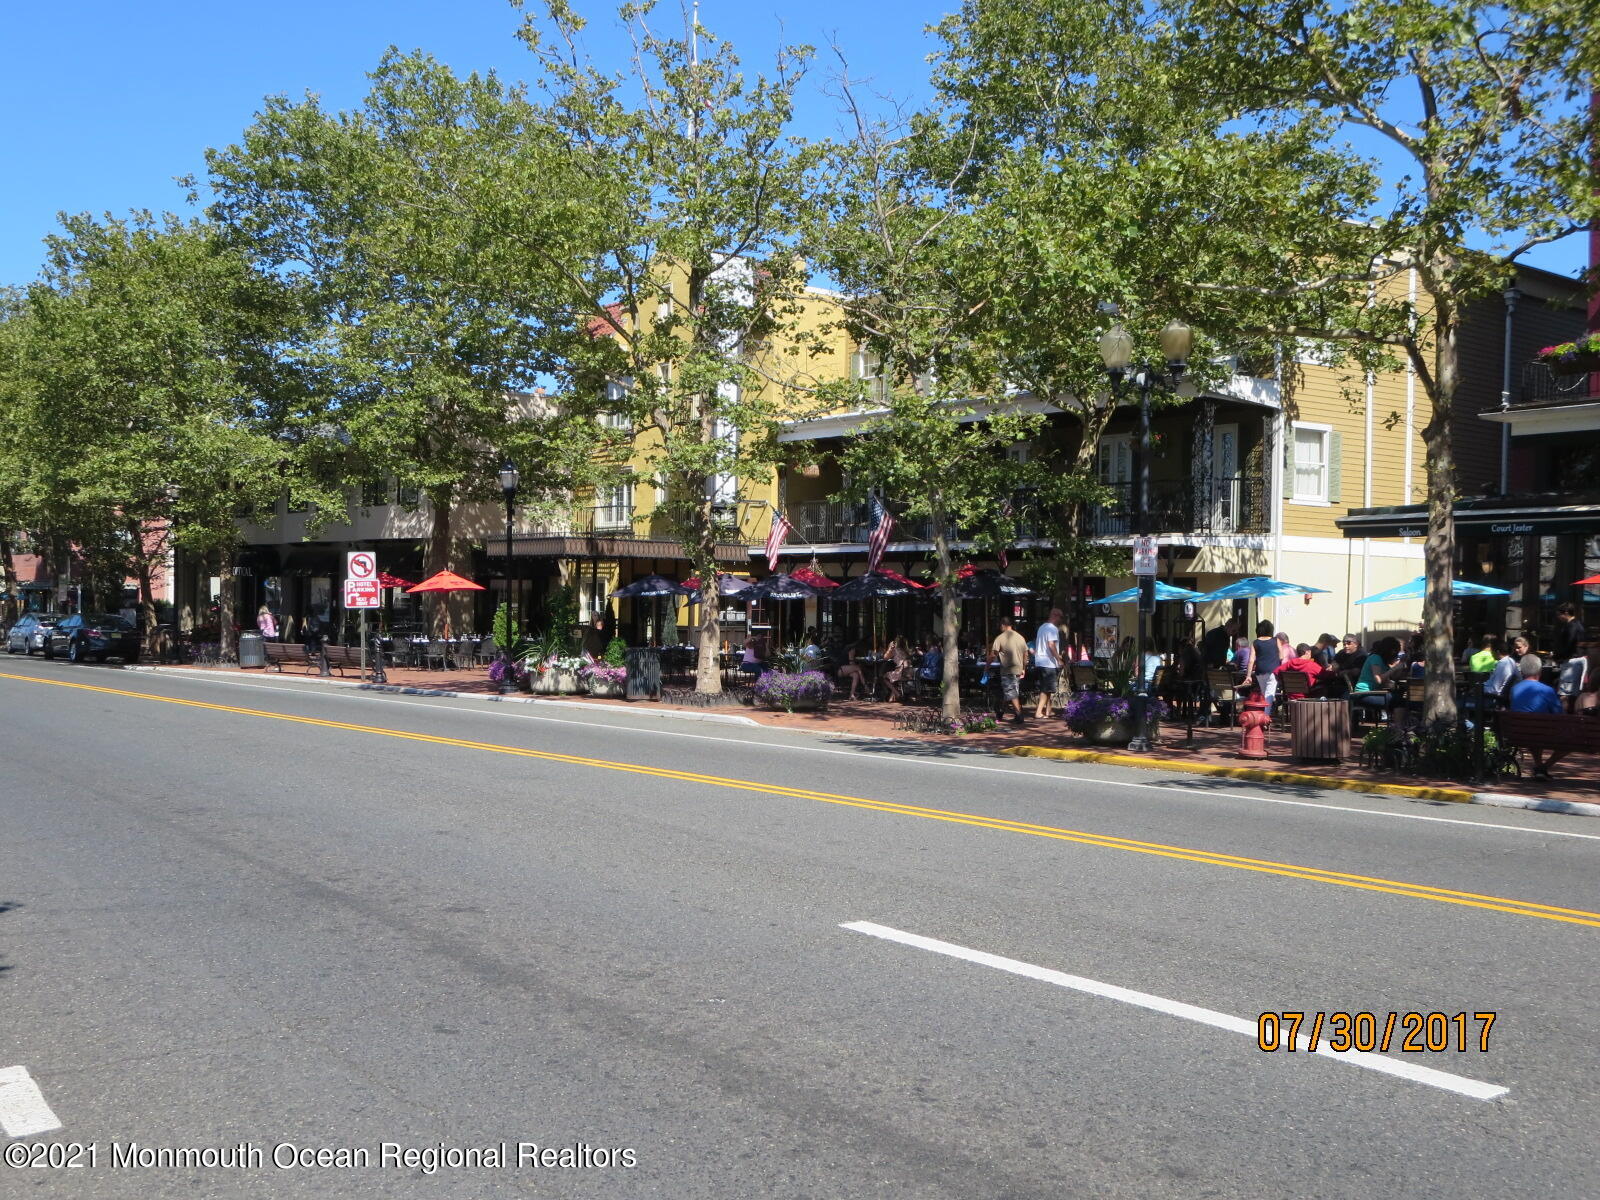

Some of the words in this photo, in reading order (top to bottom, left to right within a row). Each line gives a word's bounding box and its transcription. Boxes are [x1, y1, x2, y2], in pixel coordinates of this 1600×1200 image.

[1399, 527, 1421, 537] Saloon
[1491, 524, 1511, 532] Court
[1512, 523, 1533, 534] Jester
